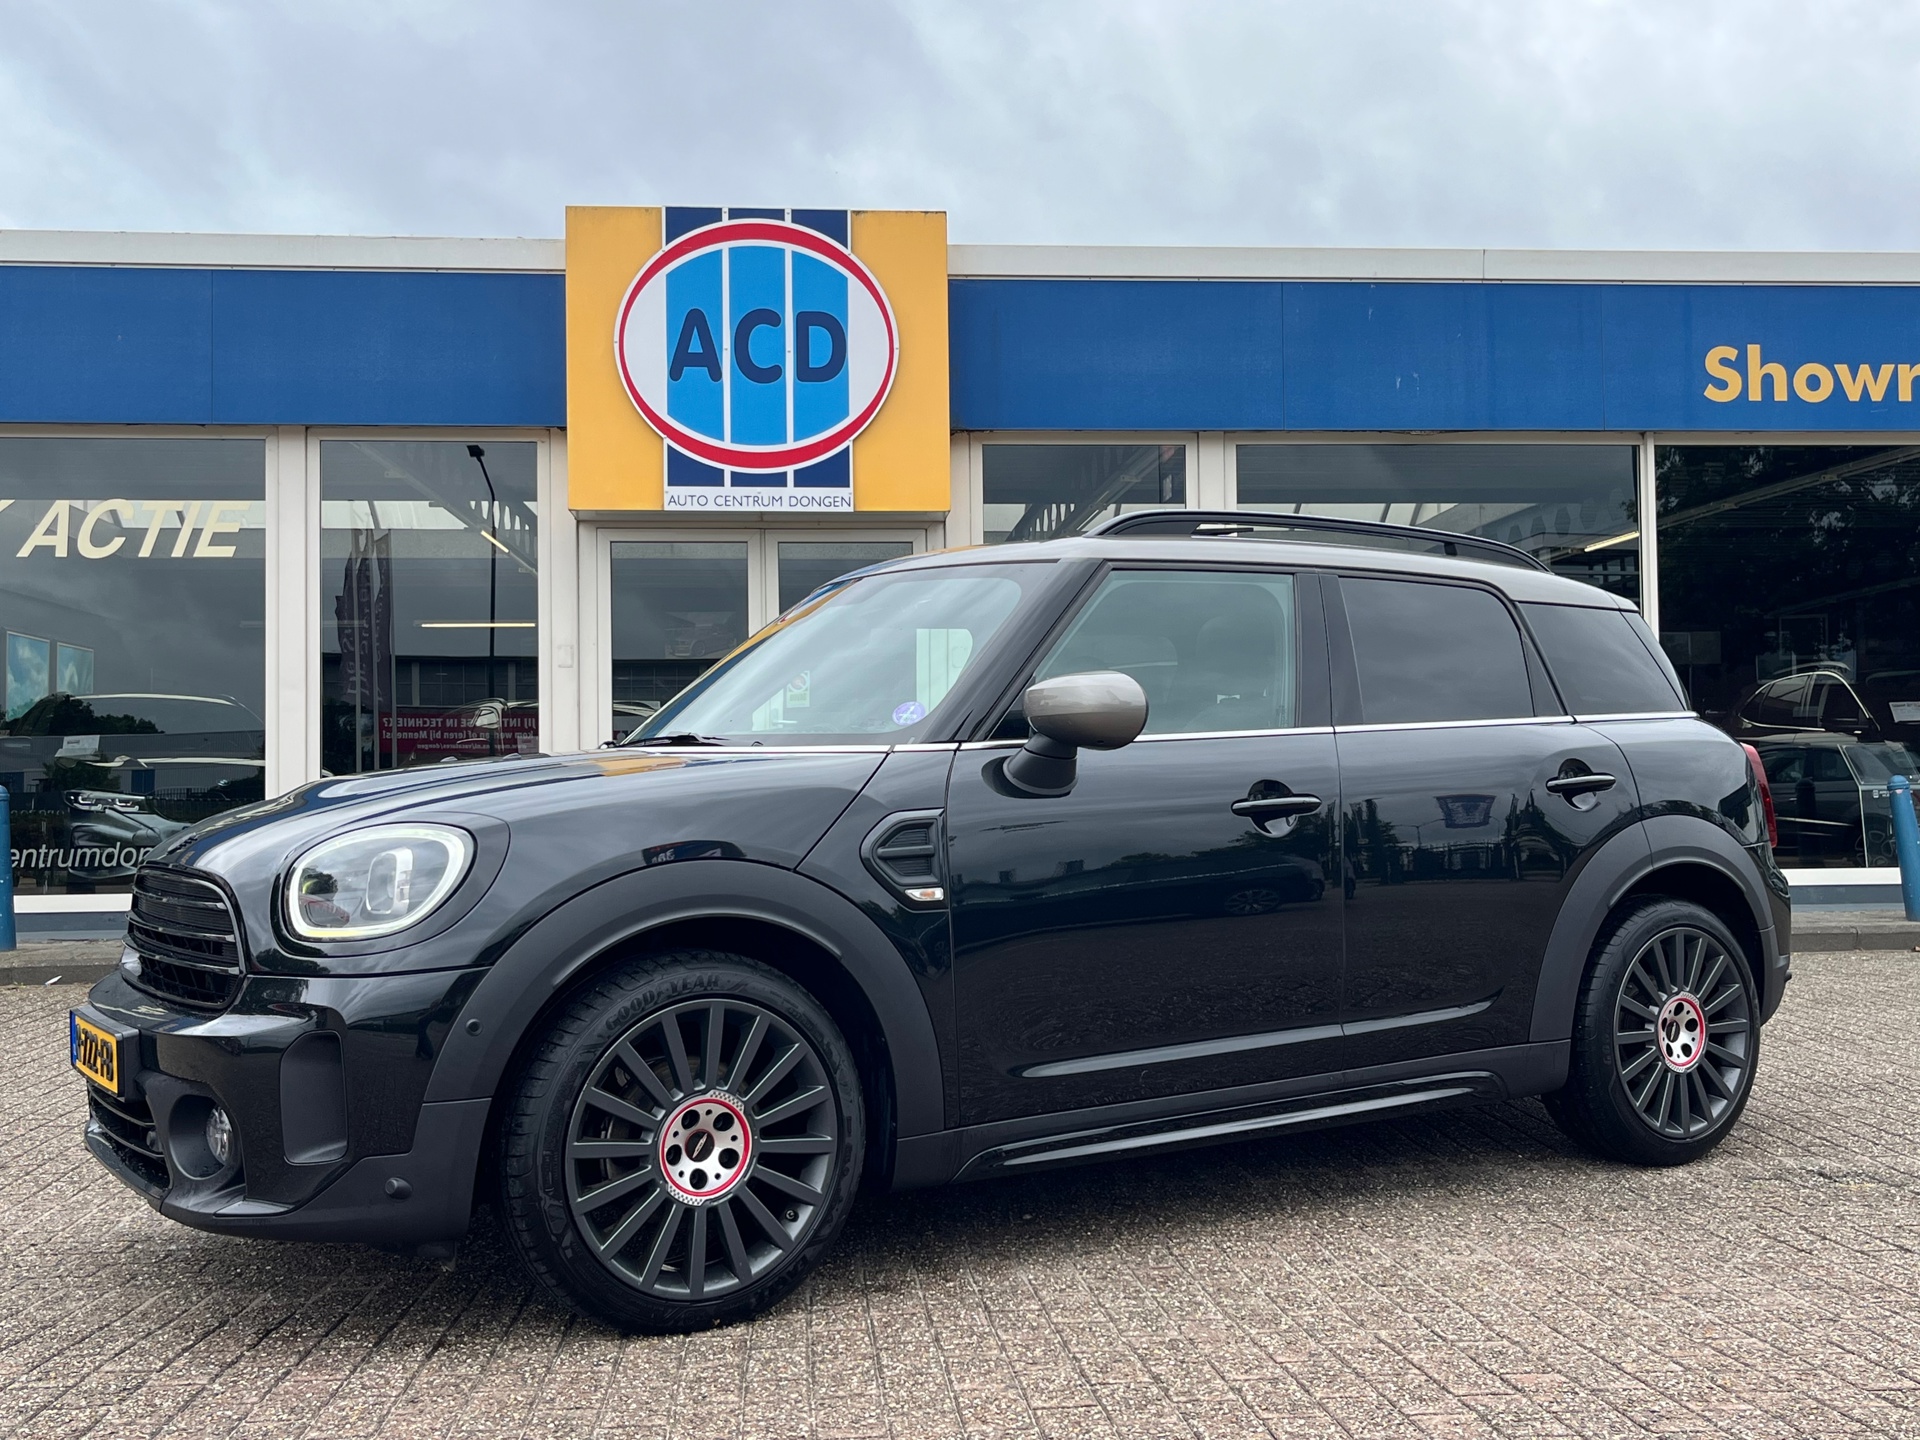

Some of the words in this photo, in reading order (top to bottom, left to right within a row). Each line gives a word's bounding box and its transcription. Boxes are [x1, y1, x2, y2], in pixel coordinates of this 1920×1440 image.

[669, 308, 847, 384] ACD
[1703, 343, 1920, 403] Showr
[15, 498, 251, 559] ACTIE
[667, 494, 709, 507] AUTO
[713, 494, 783, 508] CENTRUM
[788, 495, 852, 508] DONGEN
